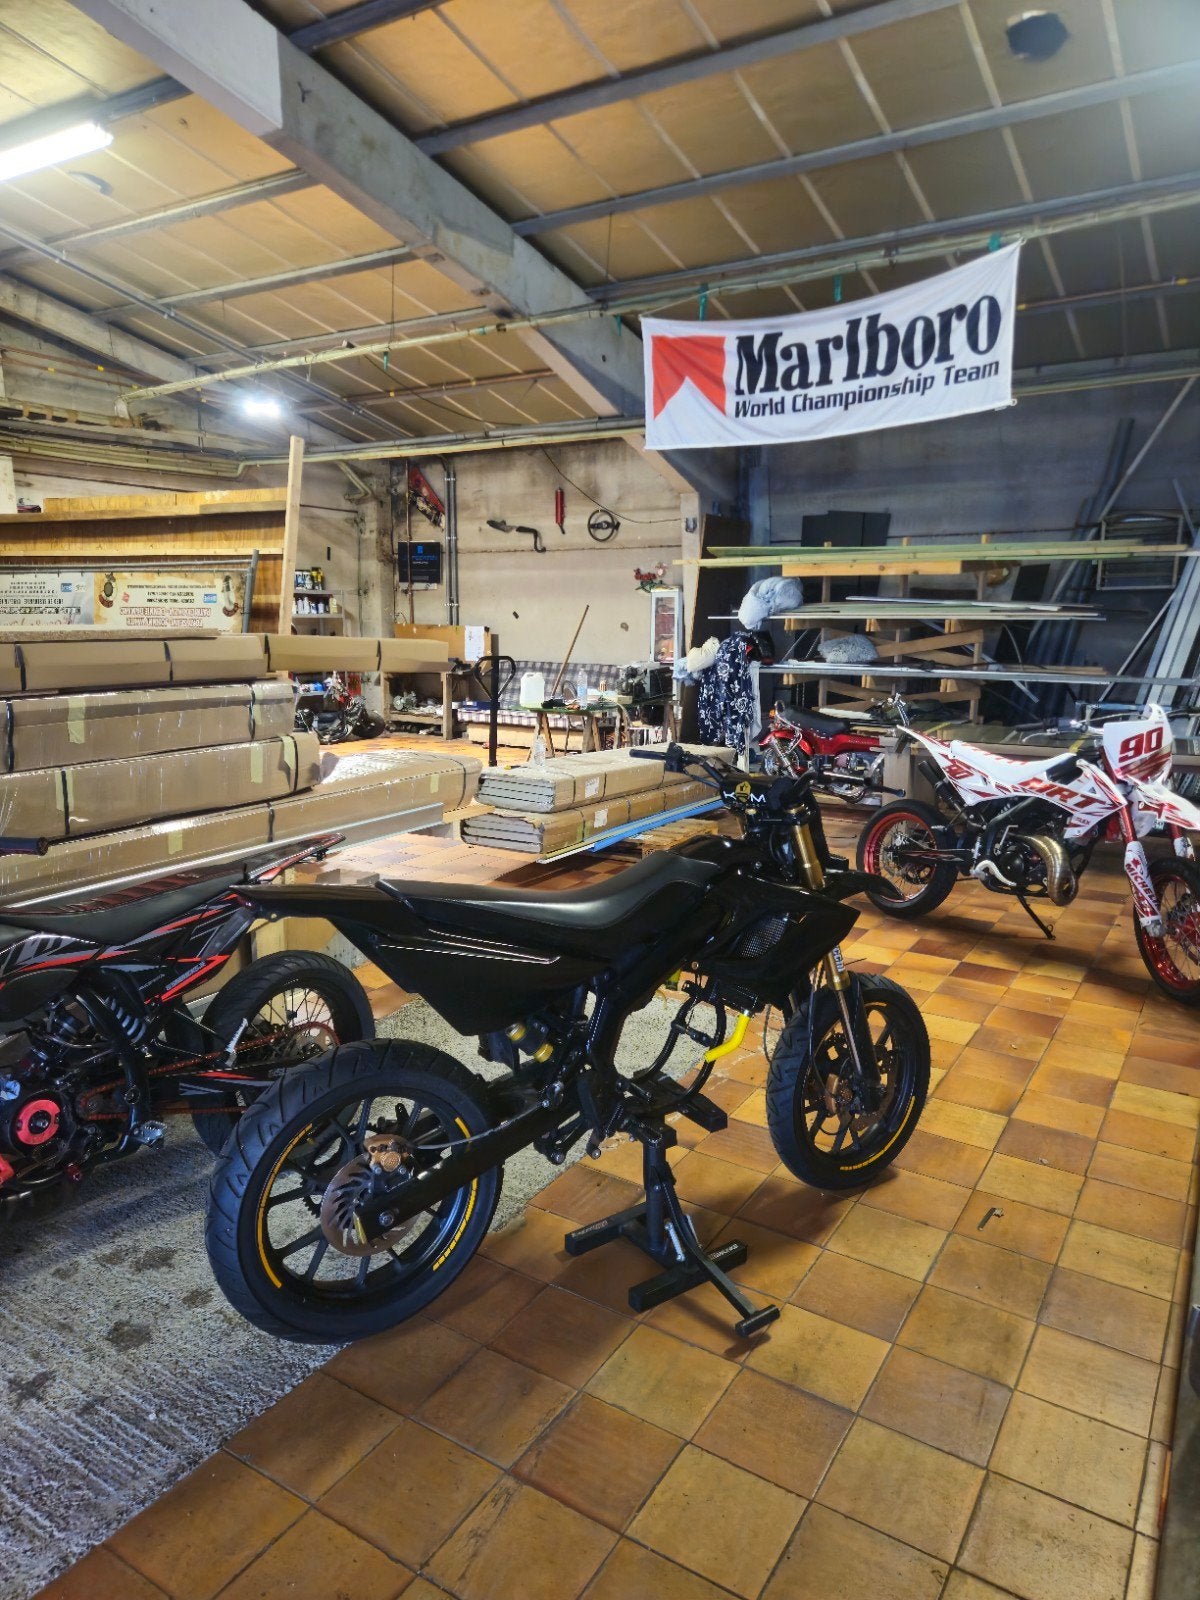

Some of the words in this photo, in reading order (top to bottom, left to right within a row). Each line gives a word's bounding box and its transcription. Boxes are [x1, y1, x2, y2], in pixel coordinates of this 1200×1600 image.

[735, 295, 1001, 396] Marlboro
[734, 397, 785, 418] World
[792, 374, 935, 410] Championship
[944, 361, 999, 386] Team
[1118, 726, 1163, 763] 90
